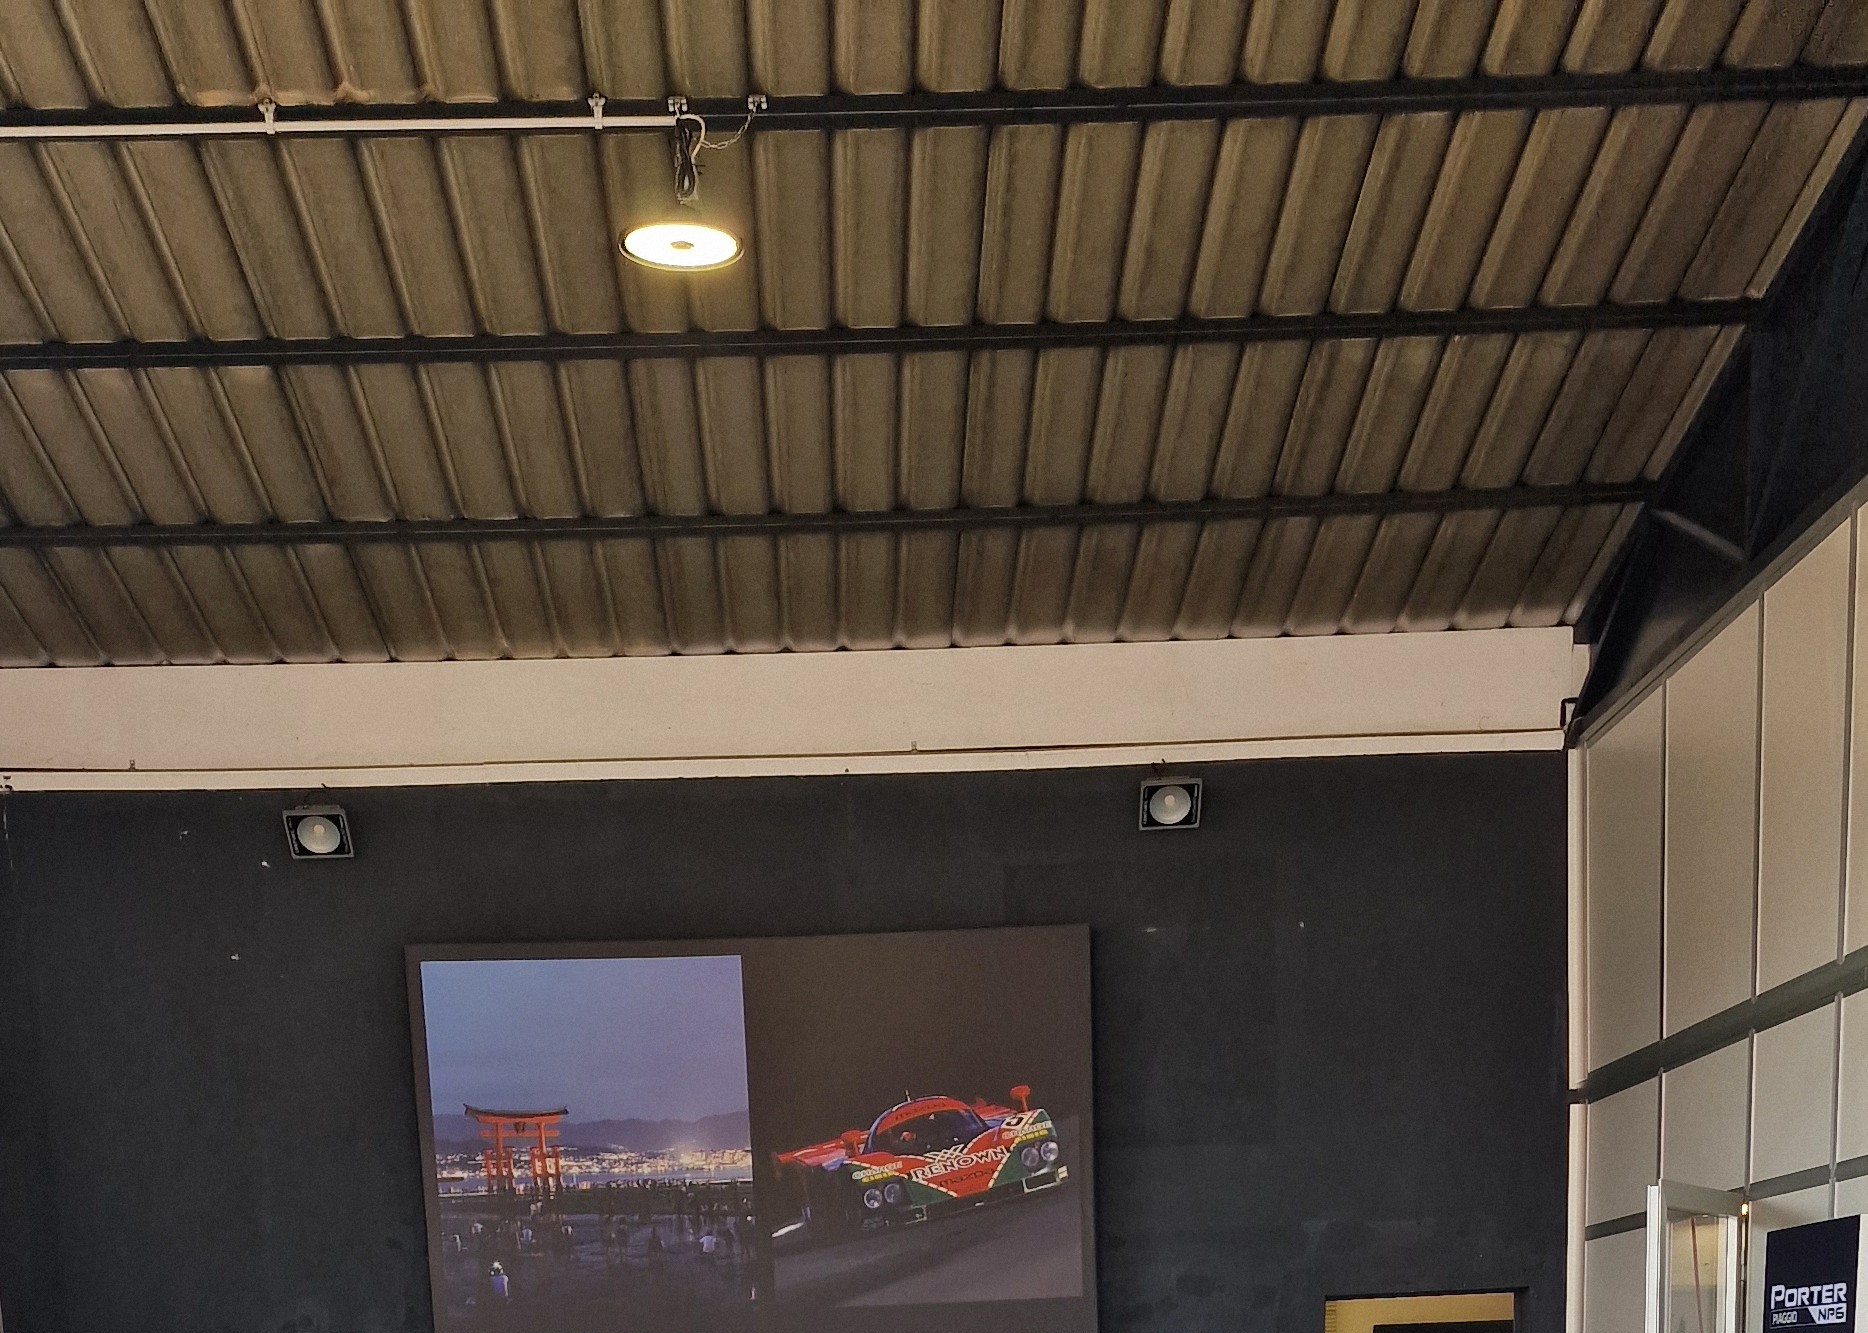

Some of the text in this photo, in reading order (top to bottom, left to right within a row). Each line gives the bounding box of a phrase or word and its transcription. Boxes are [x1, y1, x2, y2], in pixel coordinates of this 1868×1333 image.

[911, 1145, 1010, 1181] RENOWN
[1771, 1283, 1847, 1309] PORTER
[1772, 1311, 1798, 1325] PIAGGIO
